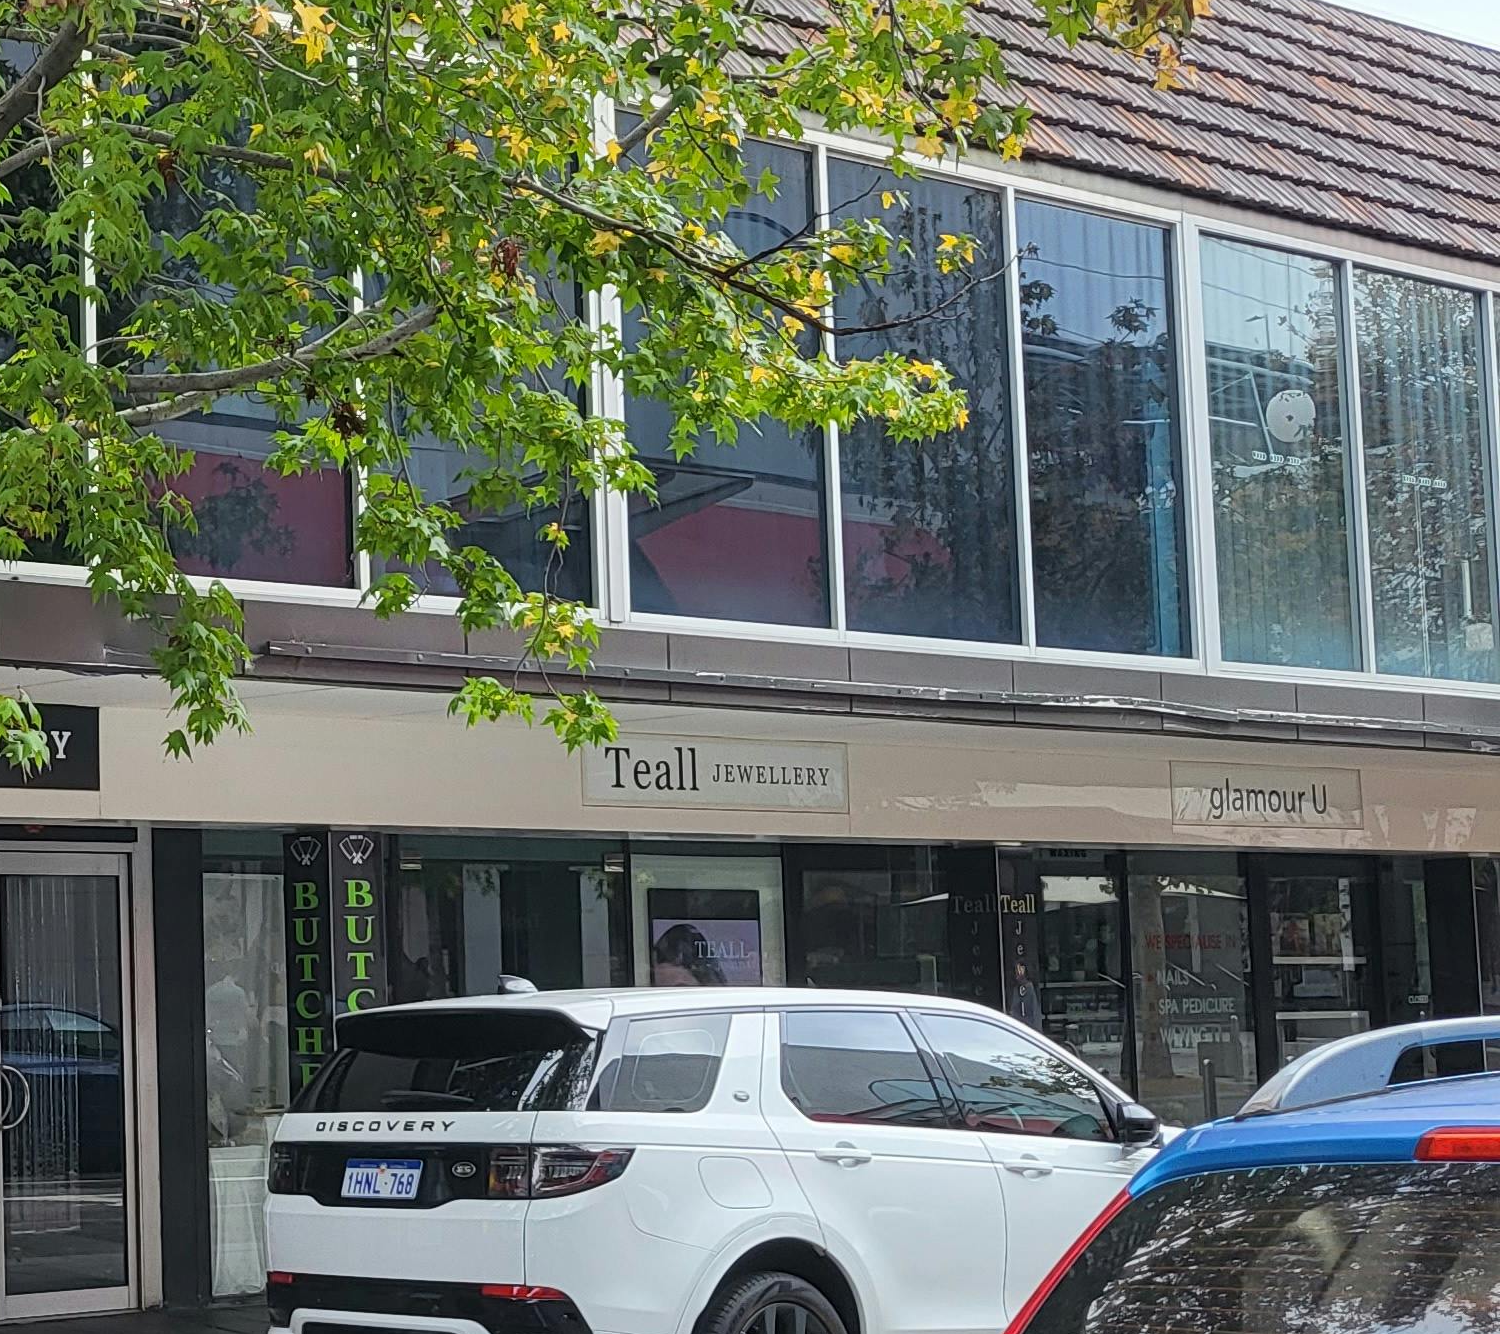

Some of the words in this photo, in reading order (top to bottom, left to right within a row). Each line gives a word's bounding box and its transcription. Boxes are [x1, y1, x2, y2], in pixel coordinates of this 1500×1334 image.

[604, 746, 700, 791] Teall
[712, 764, 830, 786] JEWELLERY
[1210, 778, 1305, 819] glamour
[1311, 783, 1327, 814] U
[1000, 893, 1036, 914] Teall
[343, 879, 376, 1013] BUTC
[694, 940, 750, 959] TEALL
[1015, 920, 1027, 1017] Jewel
[1157, 969, 1189, 985] NAILS
[1158, 998, 1179, 1015] SPA
[1182, 997, 1236, 1014] PEDICURE
[315, 1120, 456, 1132] DISCOVERY
